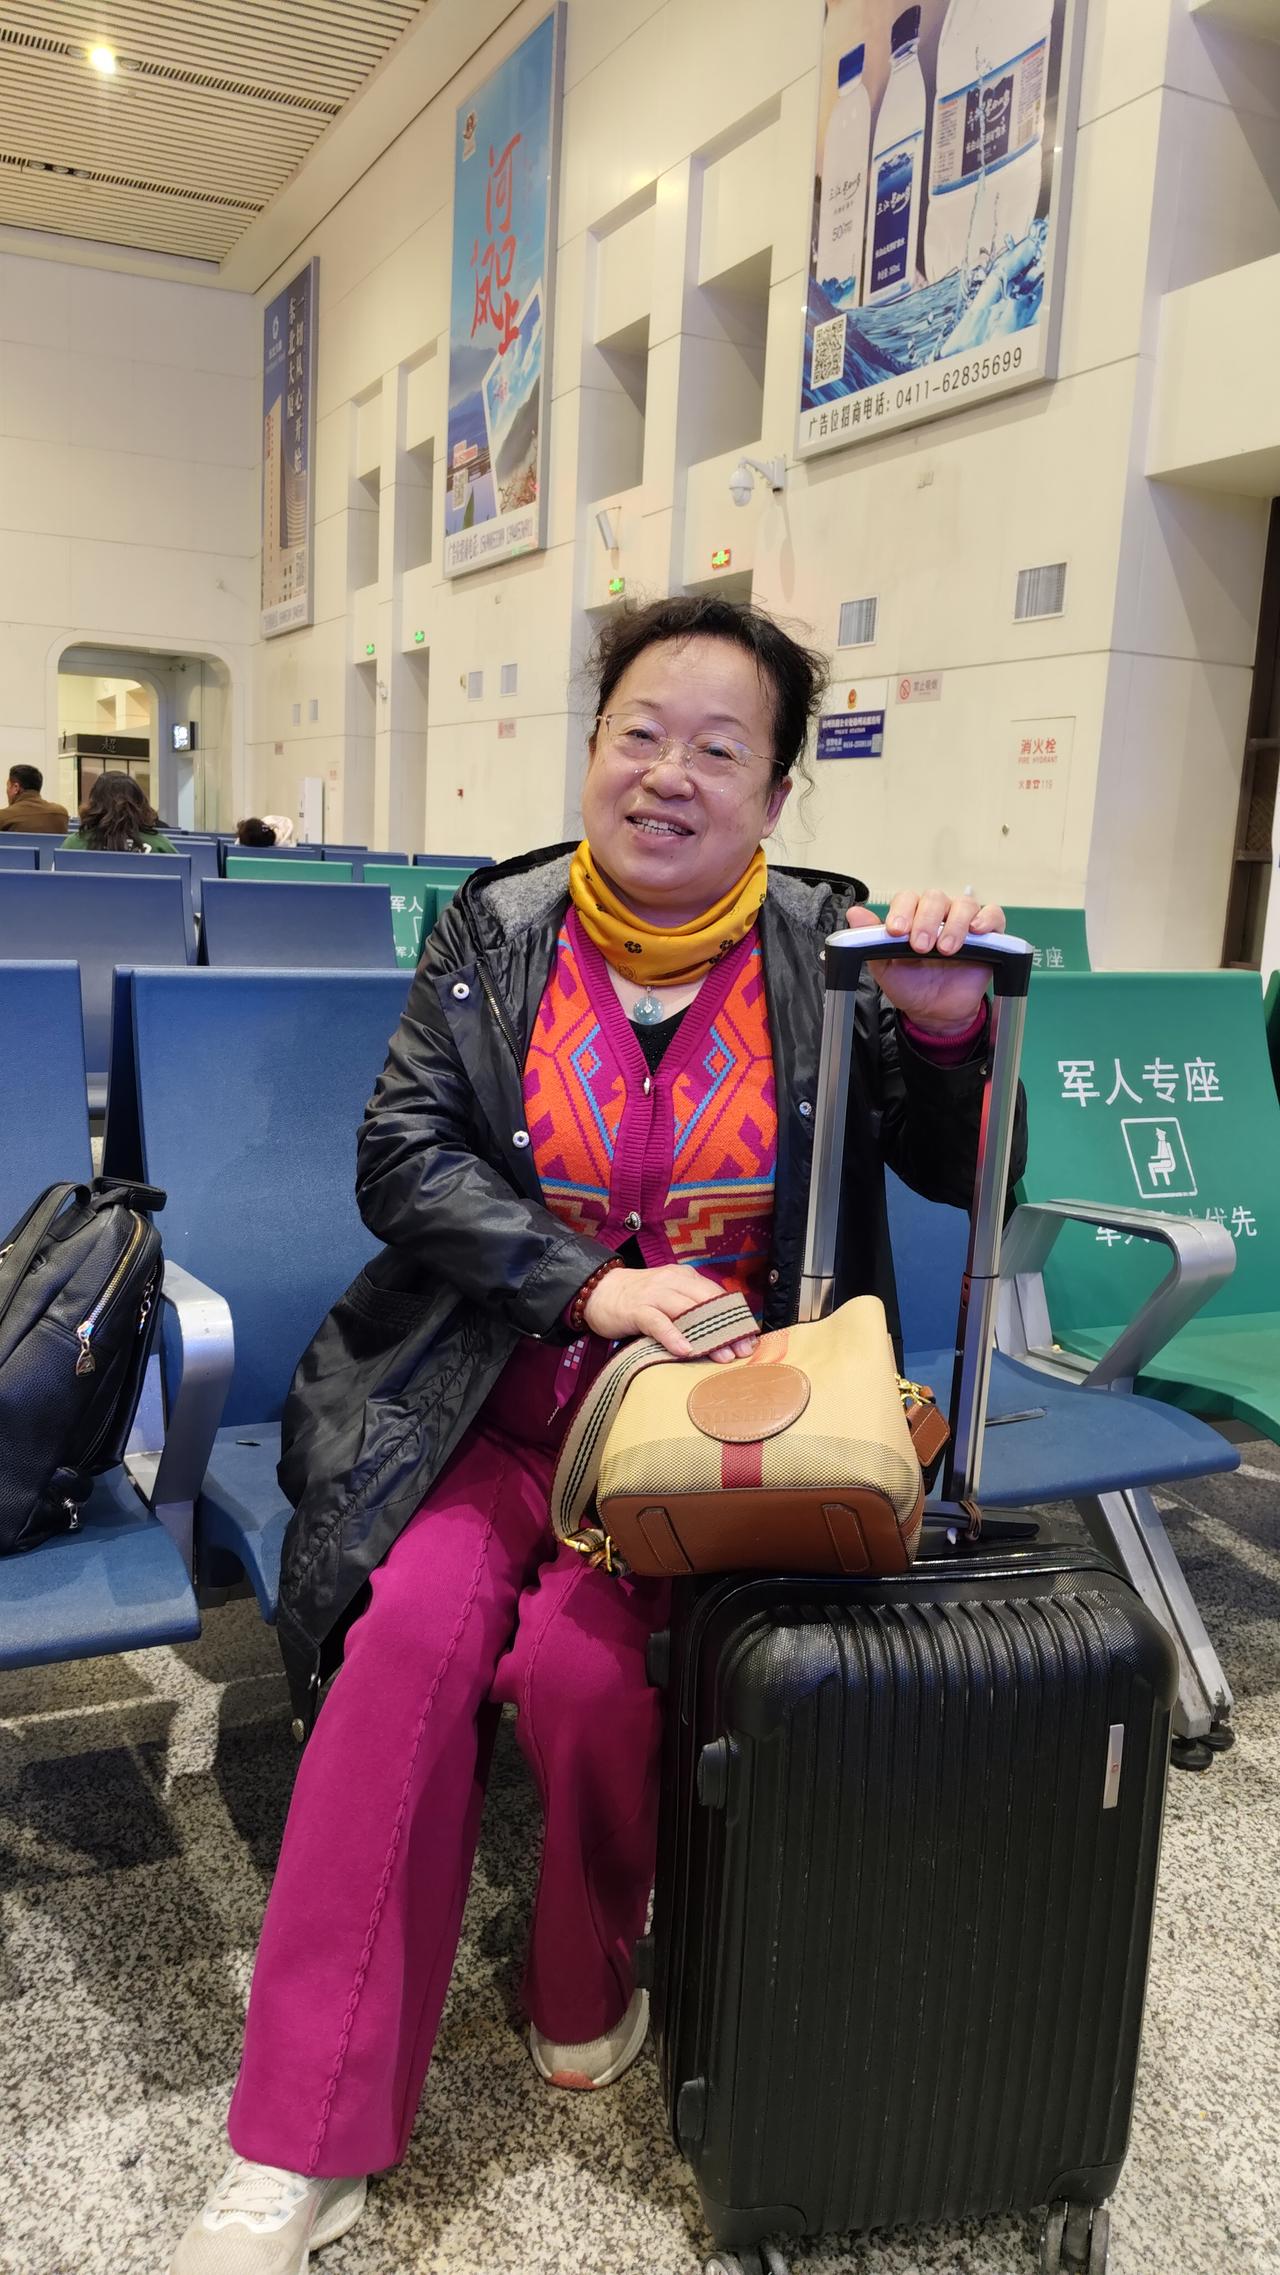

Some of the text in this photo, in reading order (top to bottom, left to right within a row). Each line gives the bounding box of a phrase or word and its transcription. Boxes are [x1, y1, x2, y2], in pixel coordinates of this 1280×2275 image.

[896, 347, 1022, 410] 0411-62835699
[1020, 737, 1057, 755] 消火栓
[1057, 1056, 1225, 1108] 军人专座
